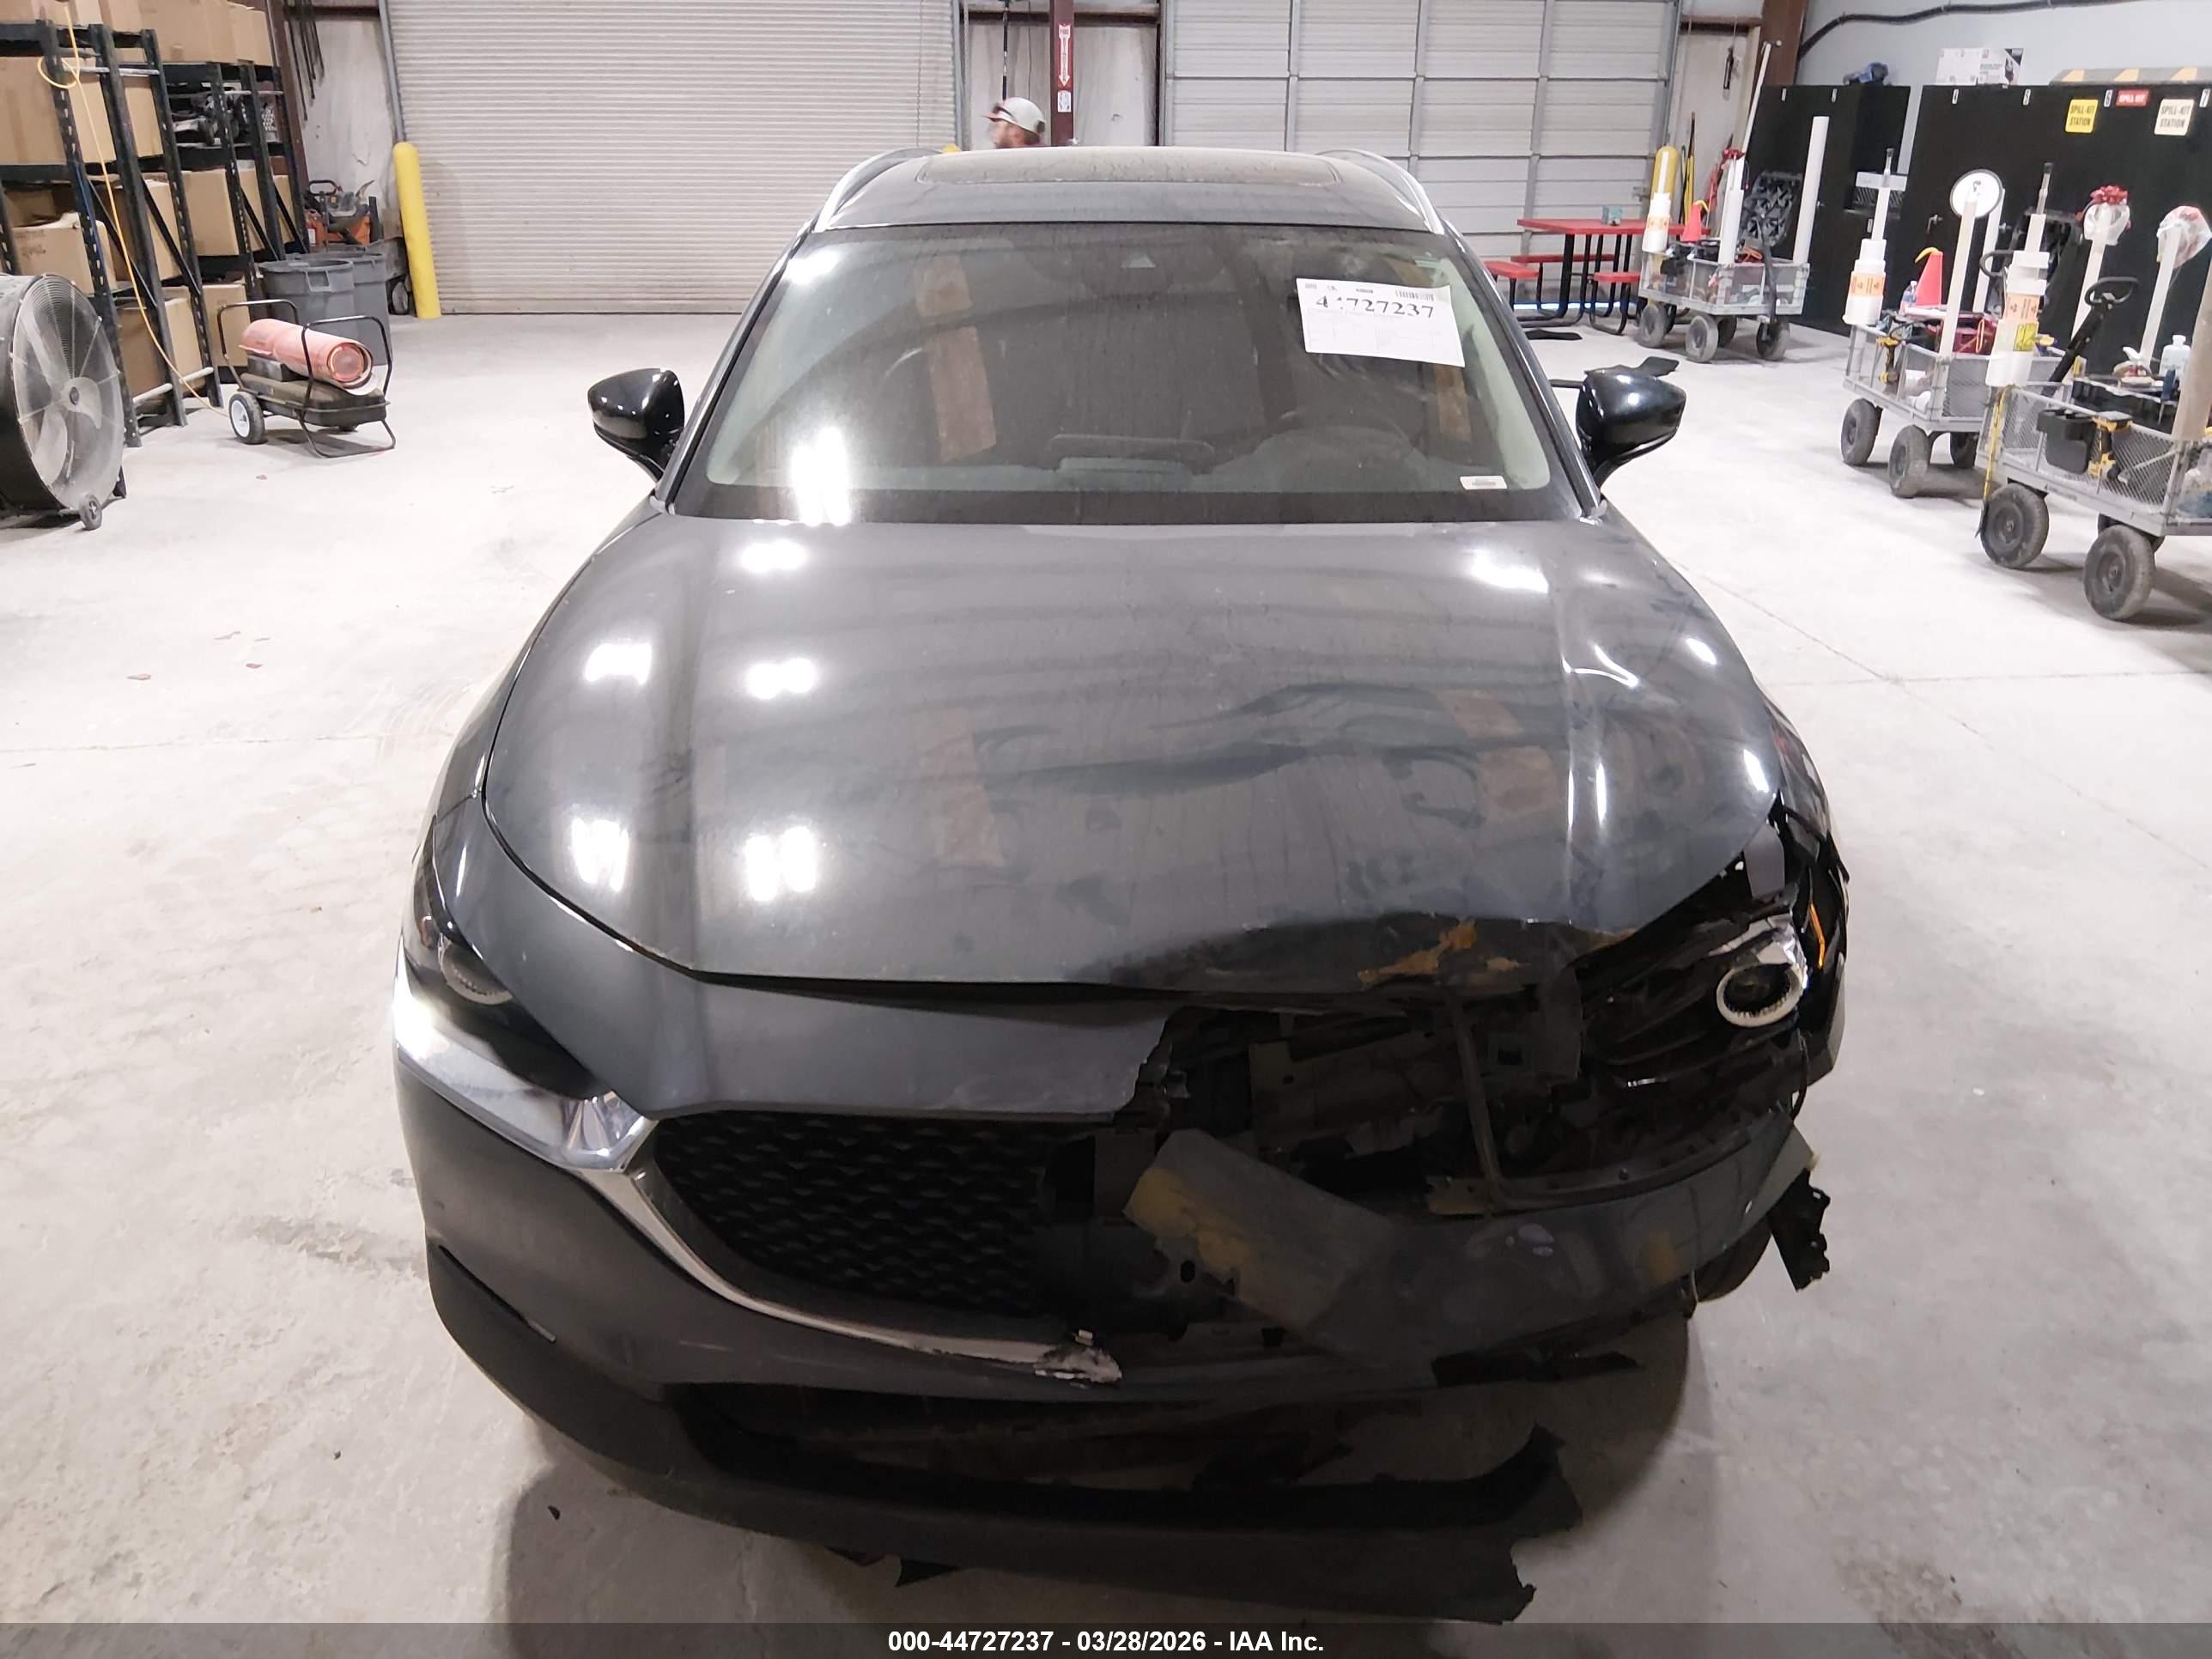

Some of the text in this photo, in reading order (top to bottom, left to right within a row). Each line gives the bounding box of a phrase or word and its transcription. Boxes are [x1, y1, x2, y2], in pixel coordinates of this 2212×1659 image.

[2070, 105, 2095, 114] SPILL-KIT
[2160, 105, 2192, 115] SPILL-KIT
[2069, 118, 2091, 126] STATION
[2159, 118, 2185, 128] STATION
[1316, 295, 1434, 319] 4727237
